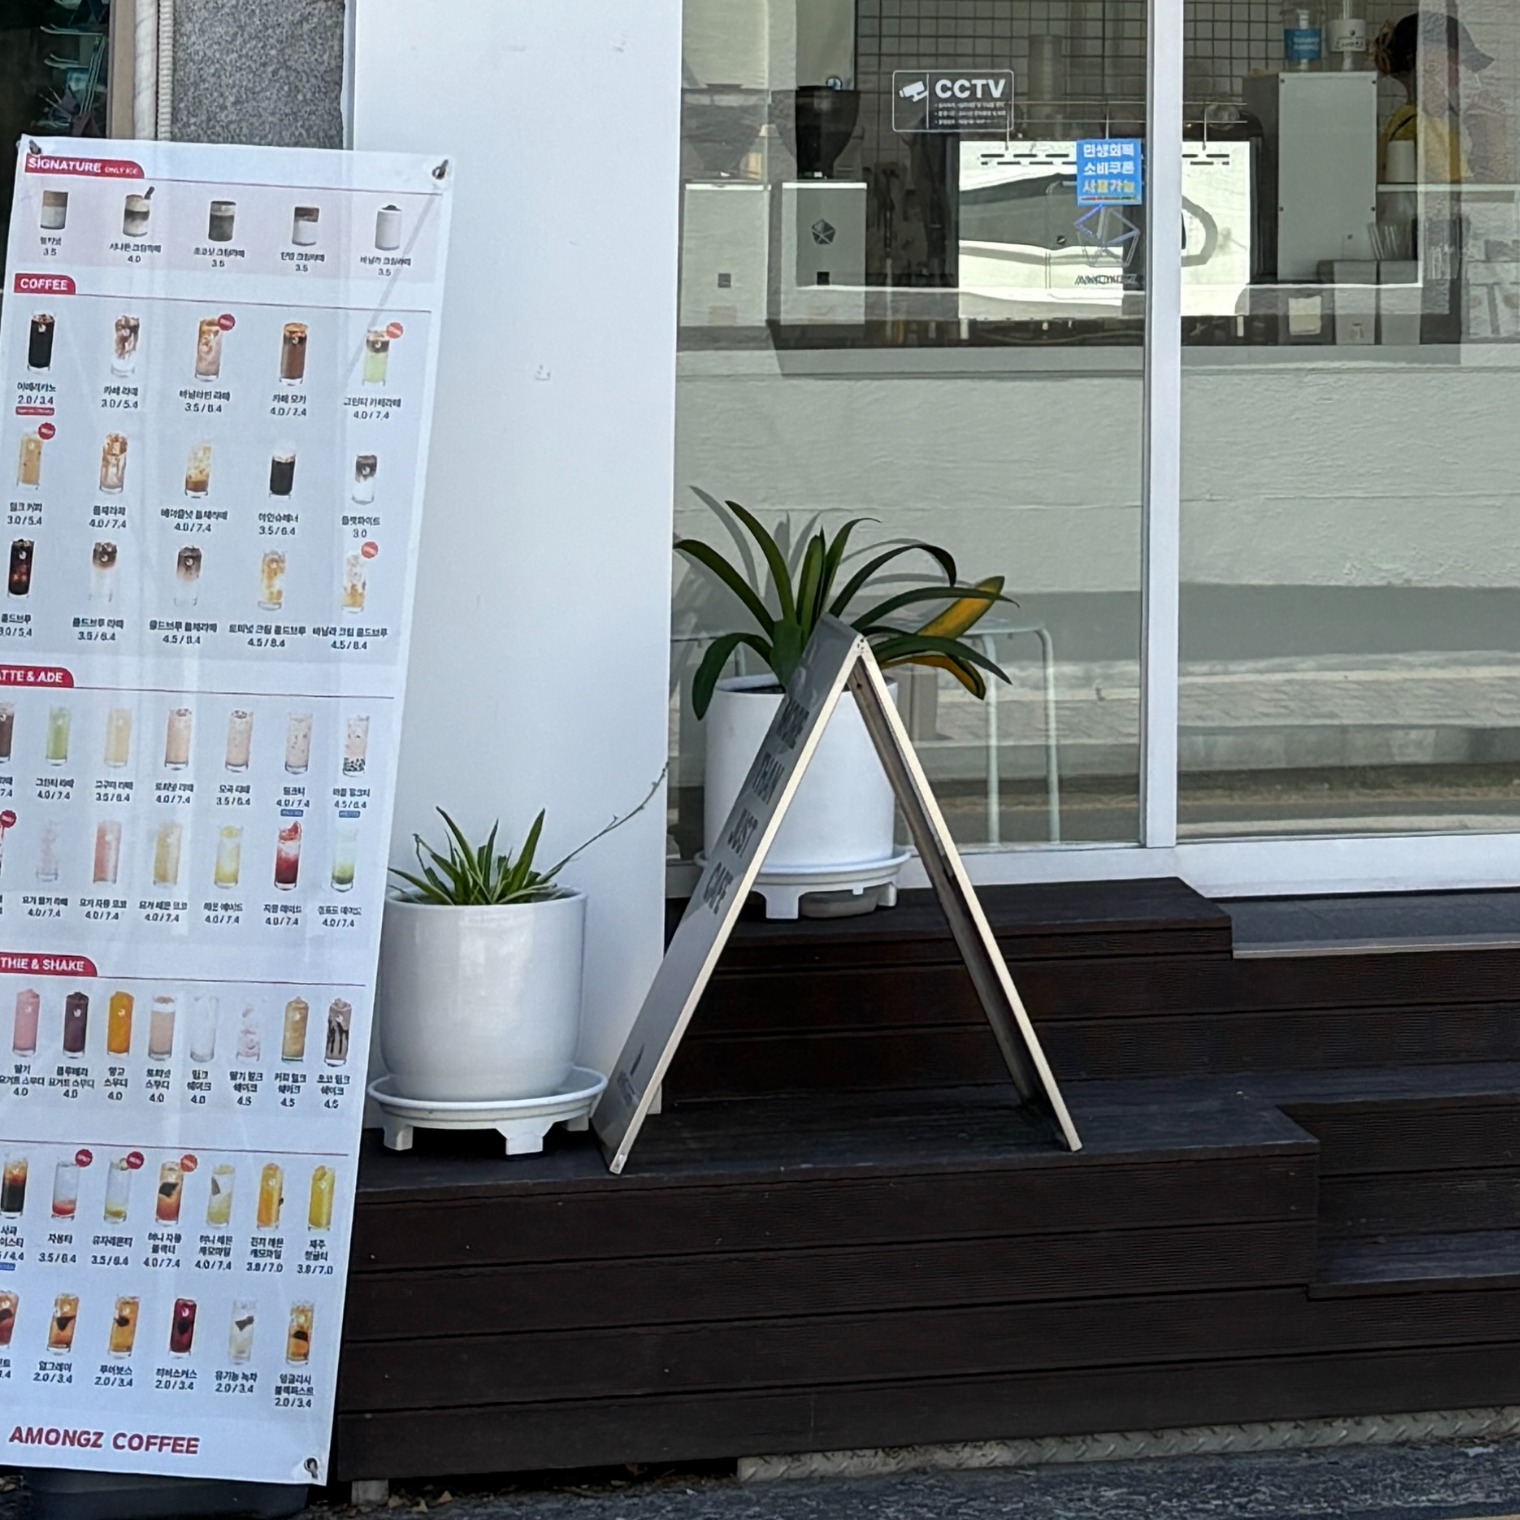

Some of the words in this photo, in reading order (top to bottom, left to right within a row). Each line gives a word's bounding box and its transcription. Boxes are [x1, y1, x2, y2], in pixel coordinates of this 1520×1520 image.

[935, 79, 1006, 99] CCTV
[28, 157, 101, 174] SIGNATURE
[1083, 161, 1134, 175] 소비쿠폰
[20, 277, 68, 292] COFFEE
[27, 671, 35, 682] &
[37, 672, 63, 683] ADE
[42, 959, 85, 972] SHAKE
[13, 1087, 28, 1097] 4.0
[107, 1091, 123, 1101] 4.0
[149, 1093, 165, 1103] 4.0
[281, 1098, 296, 1107] 4.5
[9, 1425, 104, 1448] AMONGZ
[112, 1432, 200, 1454] COFFEE
